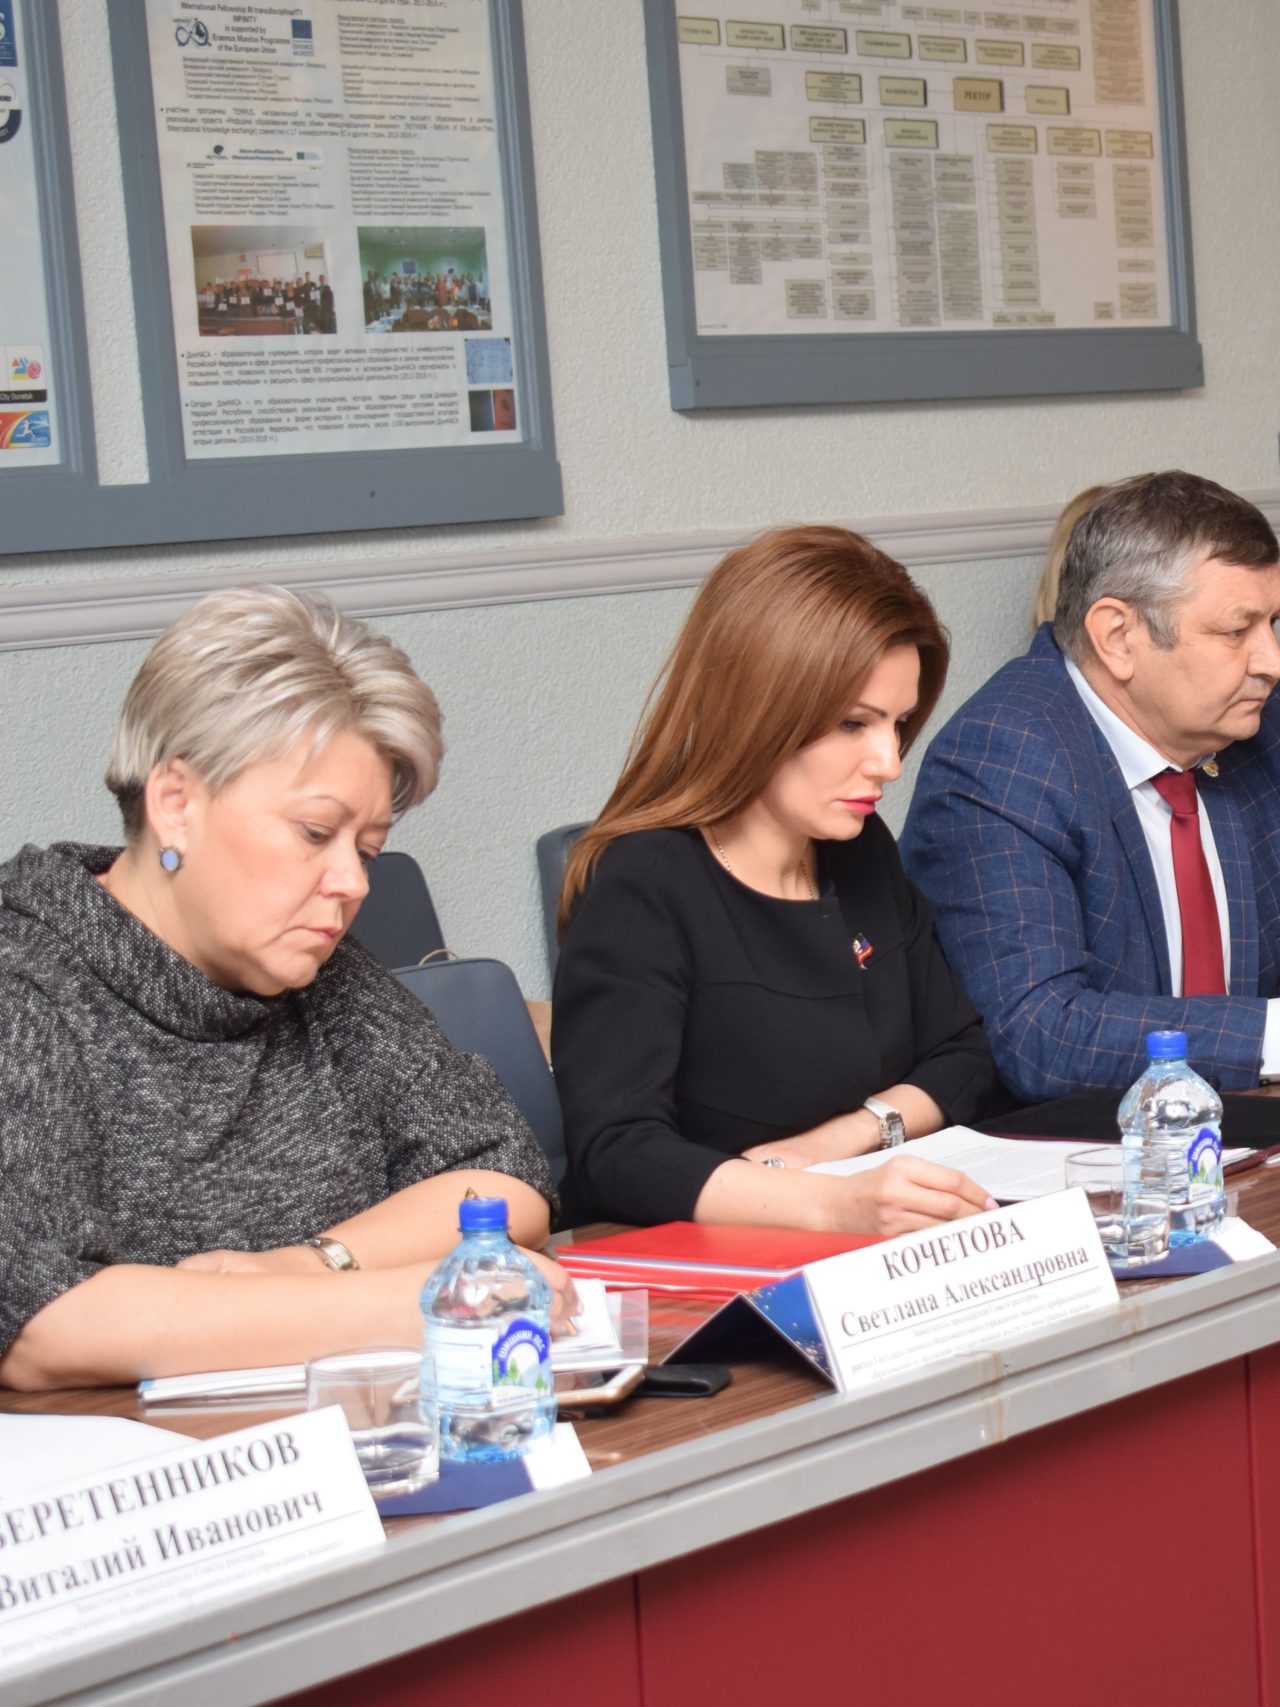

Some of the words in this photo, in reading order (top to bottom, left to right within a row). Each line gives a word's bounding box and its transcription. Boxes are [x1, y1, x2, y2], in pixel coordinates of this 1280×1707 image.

[964, 90, 992, 101] РЕКТОР
[882, 1216, 1026, 1280] КОЧЕТОВА
[841, 1291, 940, 1338] Светлана
[945, 1246, 1089, 1306] Александровна
[498, 1329, 533, 1358] ШИШКИН
[0, 1431, 300, 1549] ЕРЕТЕННИКОВ
[0, 1534, 147, 1611] Виталий
[152, 1489, 324, 1561] Иванович
